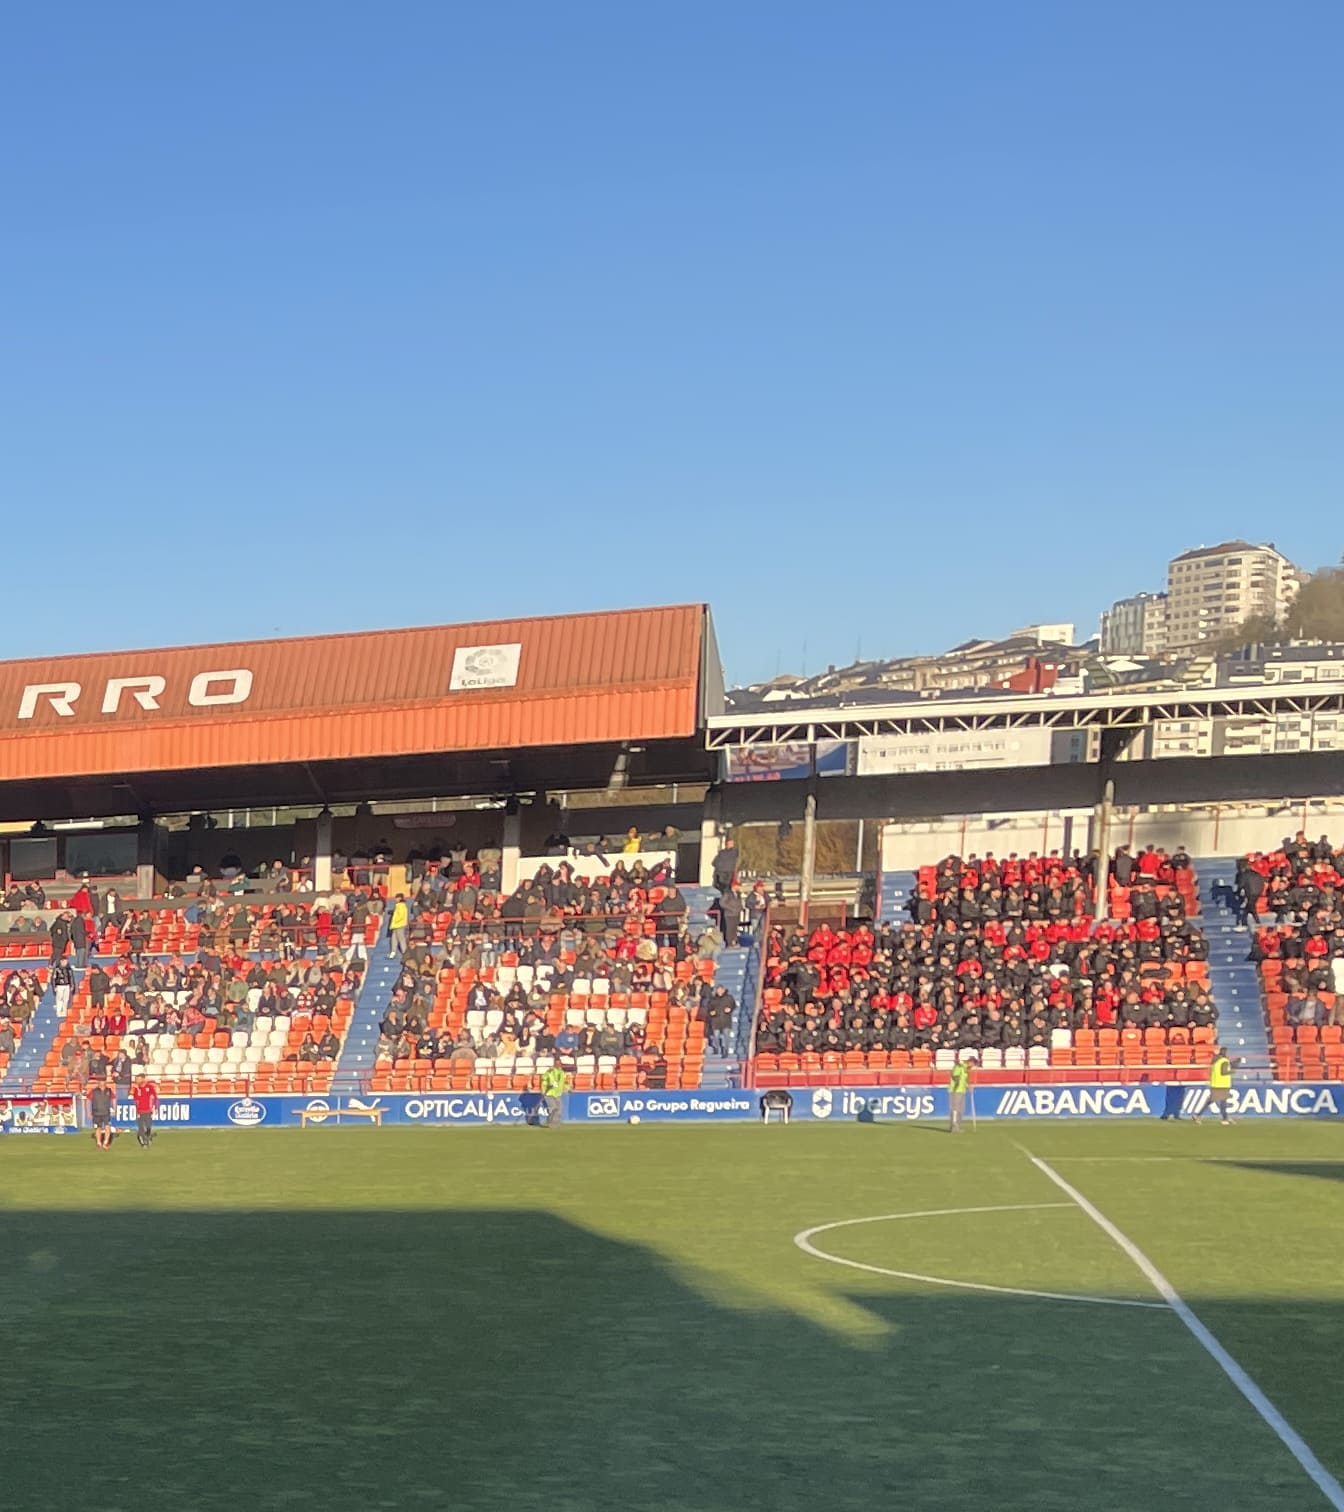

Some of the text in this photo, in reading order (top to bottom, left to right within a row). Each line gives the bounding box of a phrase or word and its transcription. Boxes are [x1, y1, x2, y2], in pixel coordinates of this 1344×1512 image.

[623, 1098, 750, 1113] AD Grupo Regueira
[1009, 1089, 1151, 1114] ABANCA
[116, 1102, 190, 1121] FEDACIÓN
